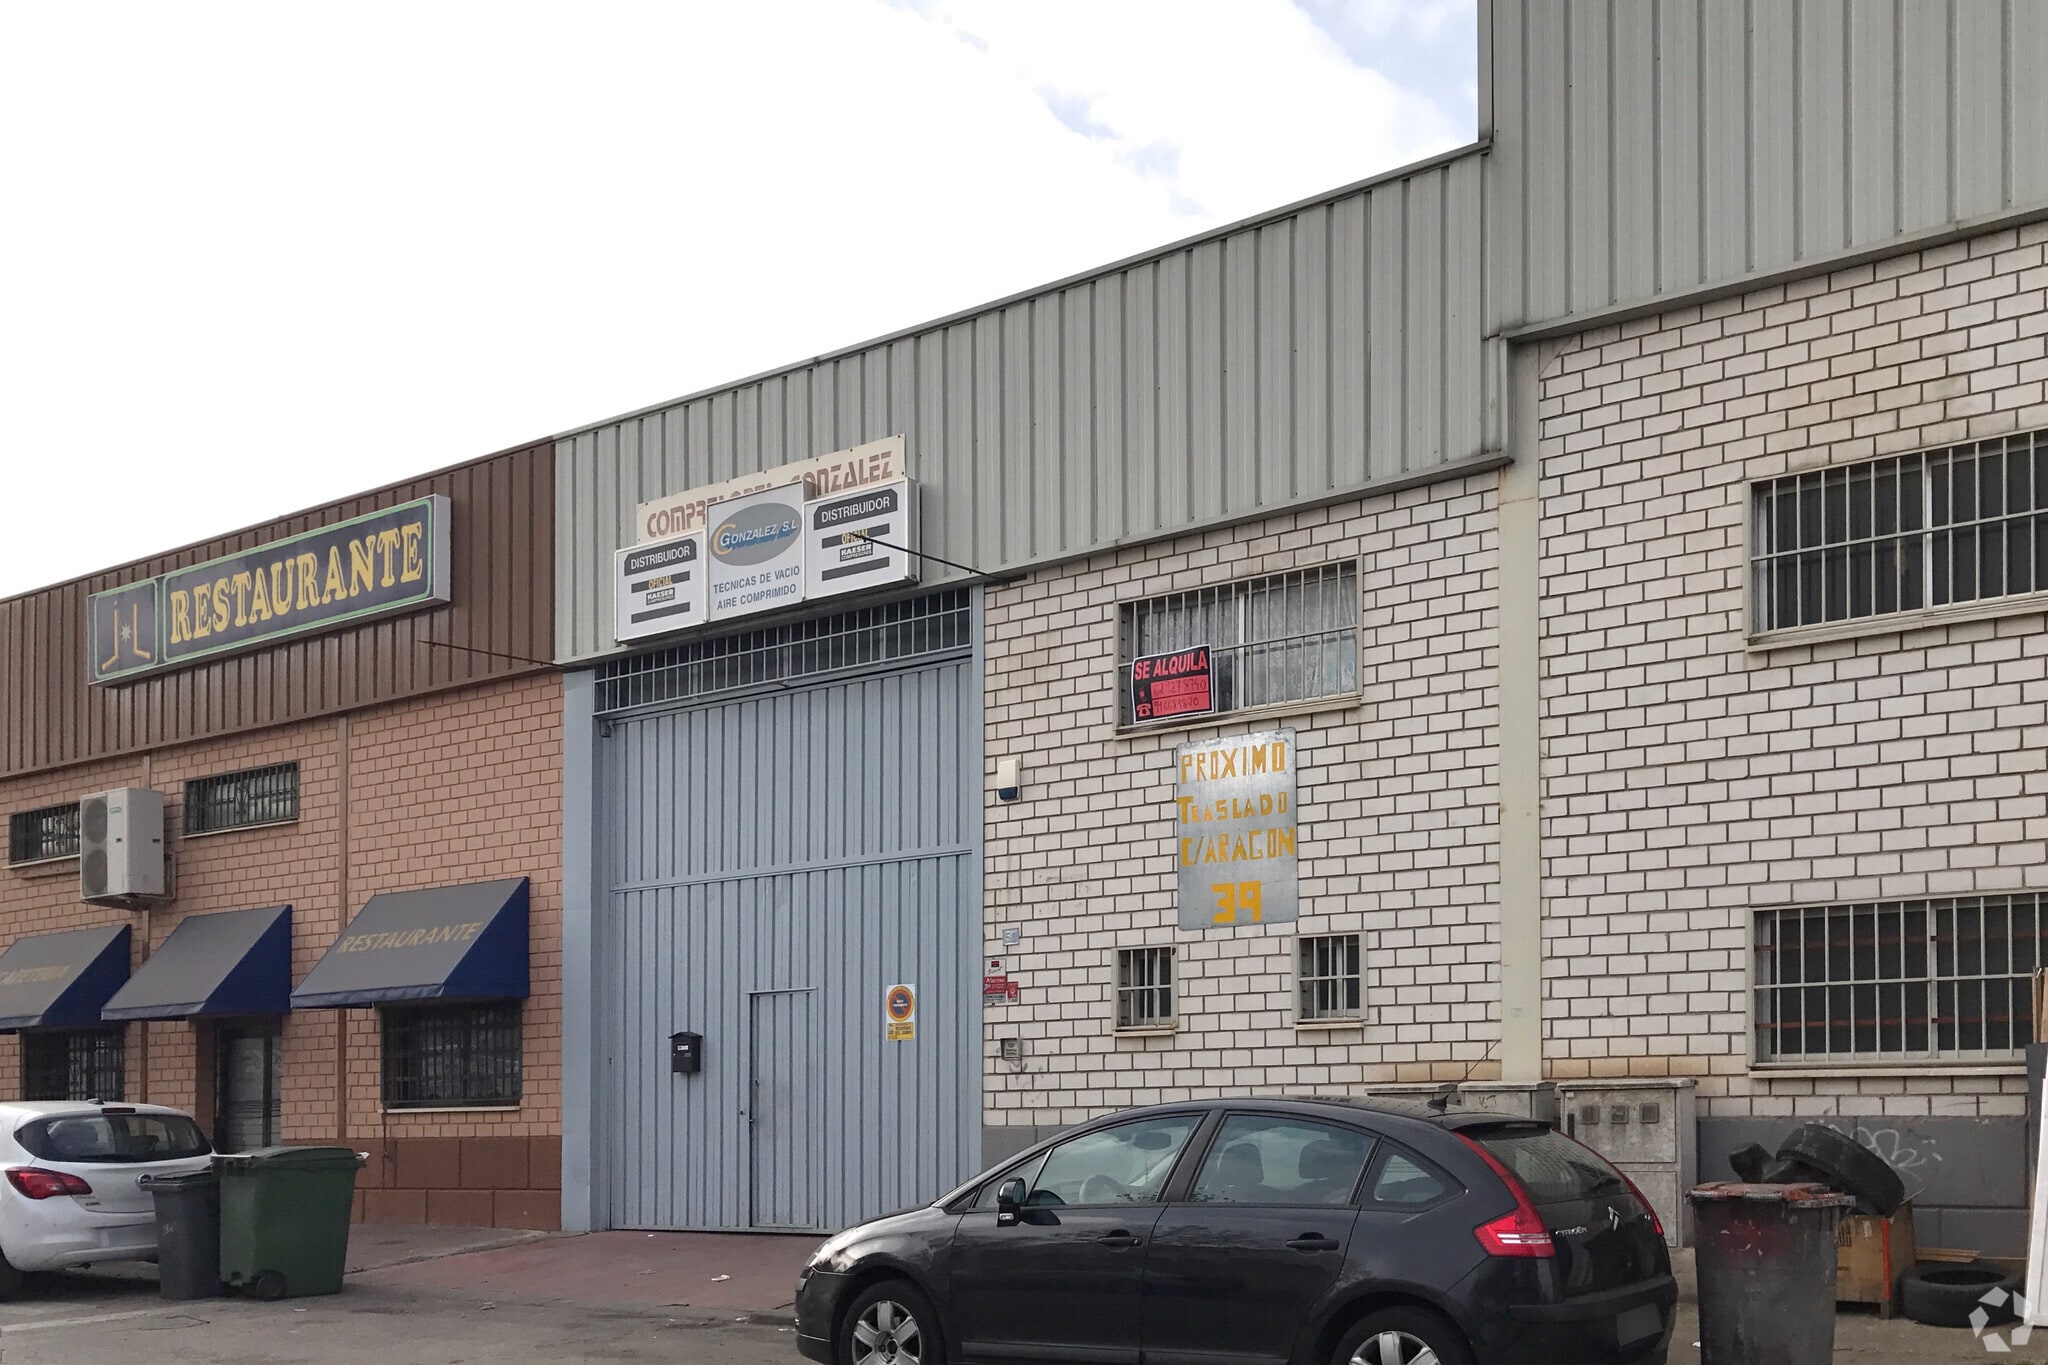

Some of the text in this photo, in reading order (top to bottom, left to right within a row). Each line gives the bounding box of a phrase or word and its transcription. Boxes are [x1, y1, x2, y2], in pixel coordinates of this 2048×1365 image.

[790, 450, 893, 497] NZALEZ
[821, 496, 890, 523] DISTRIBUIDOR
[630, 545, 690, 570] DISTRIBUIDOR
[841, 543, 872, 556] KAESER
[169, 520, 424, 645] RESTAURANTE
[647, 588, 674, 600] KAESER
[713, 565, 800, 594] TECNICAS DE VACIO
[717, 583, 797, 610] AIRE COMPRIMIDO
[1134, 650, 1209, 681] SE ALQUILA
[1181, 741, 1285, 785] PROXIMO
[1176, 791, 1288, 825] TRASLADO
[1181, 826, 1296, 867] C/ARAGON
[1211, 880, 1262, 923] 39
[335, 920, 483, 954] RESTAURANTE
